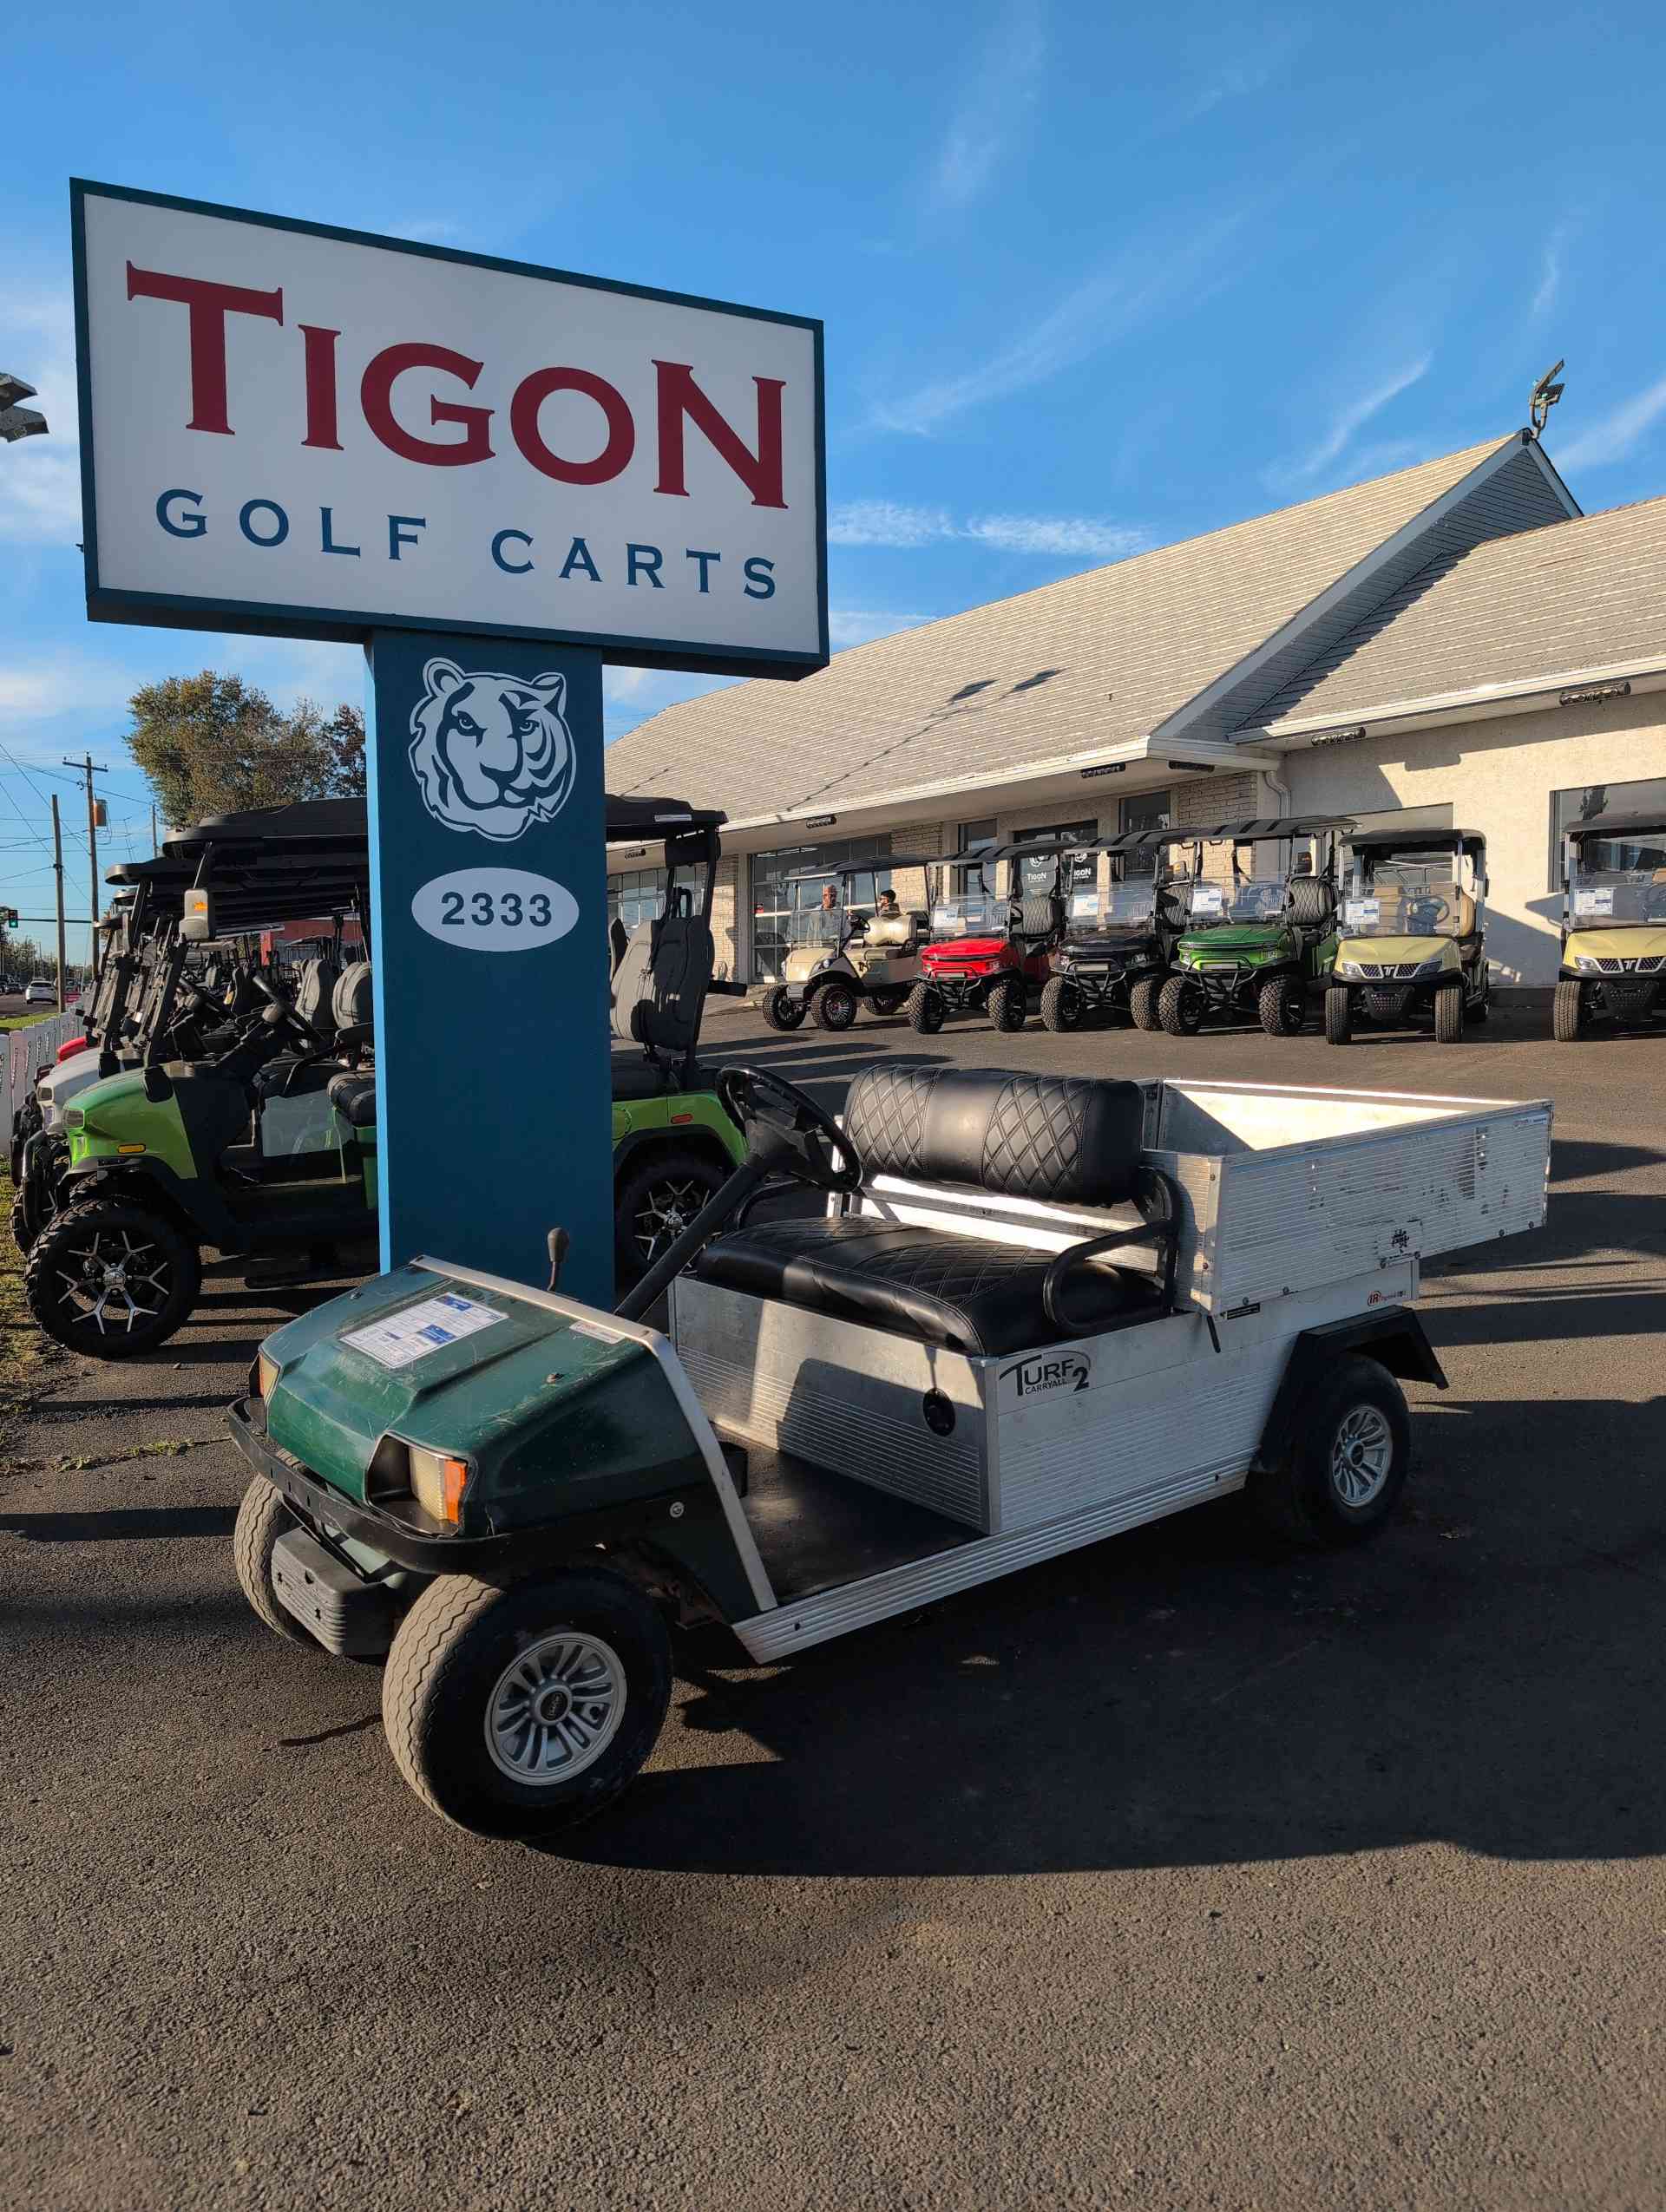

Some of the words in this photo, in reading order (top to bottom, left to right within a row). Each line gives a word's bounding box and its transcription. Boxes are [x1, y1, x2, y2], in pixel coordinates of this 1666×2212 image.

[127, 259, 789, 510] TIGON
[155, 488, 427, 561] GOLF
[491, 529, 777, 600] CARTS
[1072, 867, 1092, 876] IGON
[441, 891, 552, 926] 2333
[999, 1354, 1075, 1397] TURF
[1072, 1366, 1090, 1392] 2
[1024, 1378, 1068, 1395] CARRYALL
